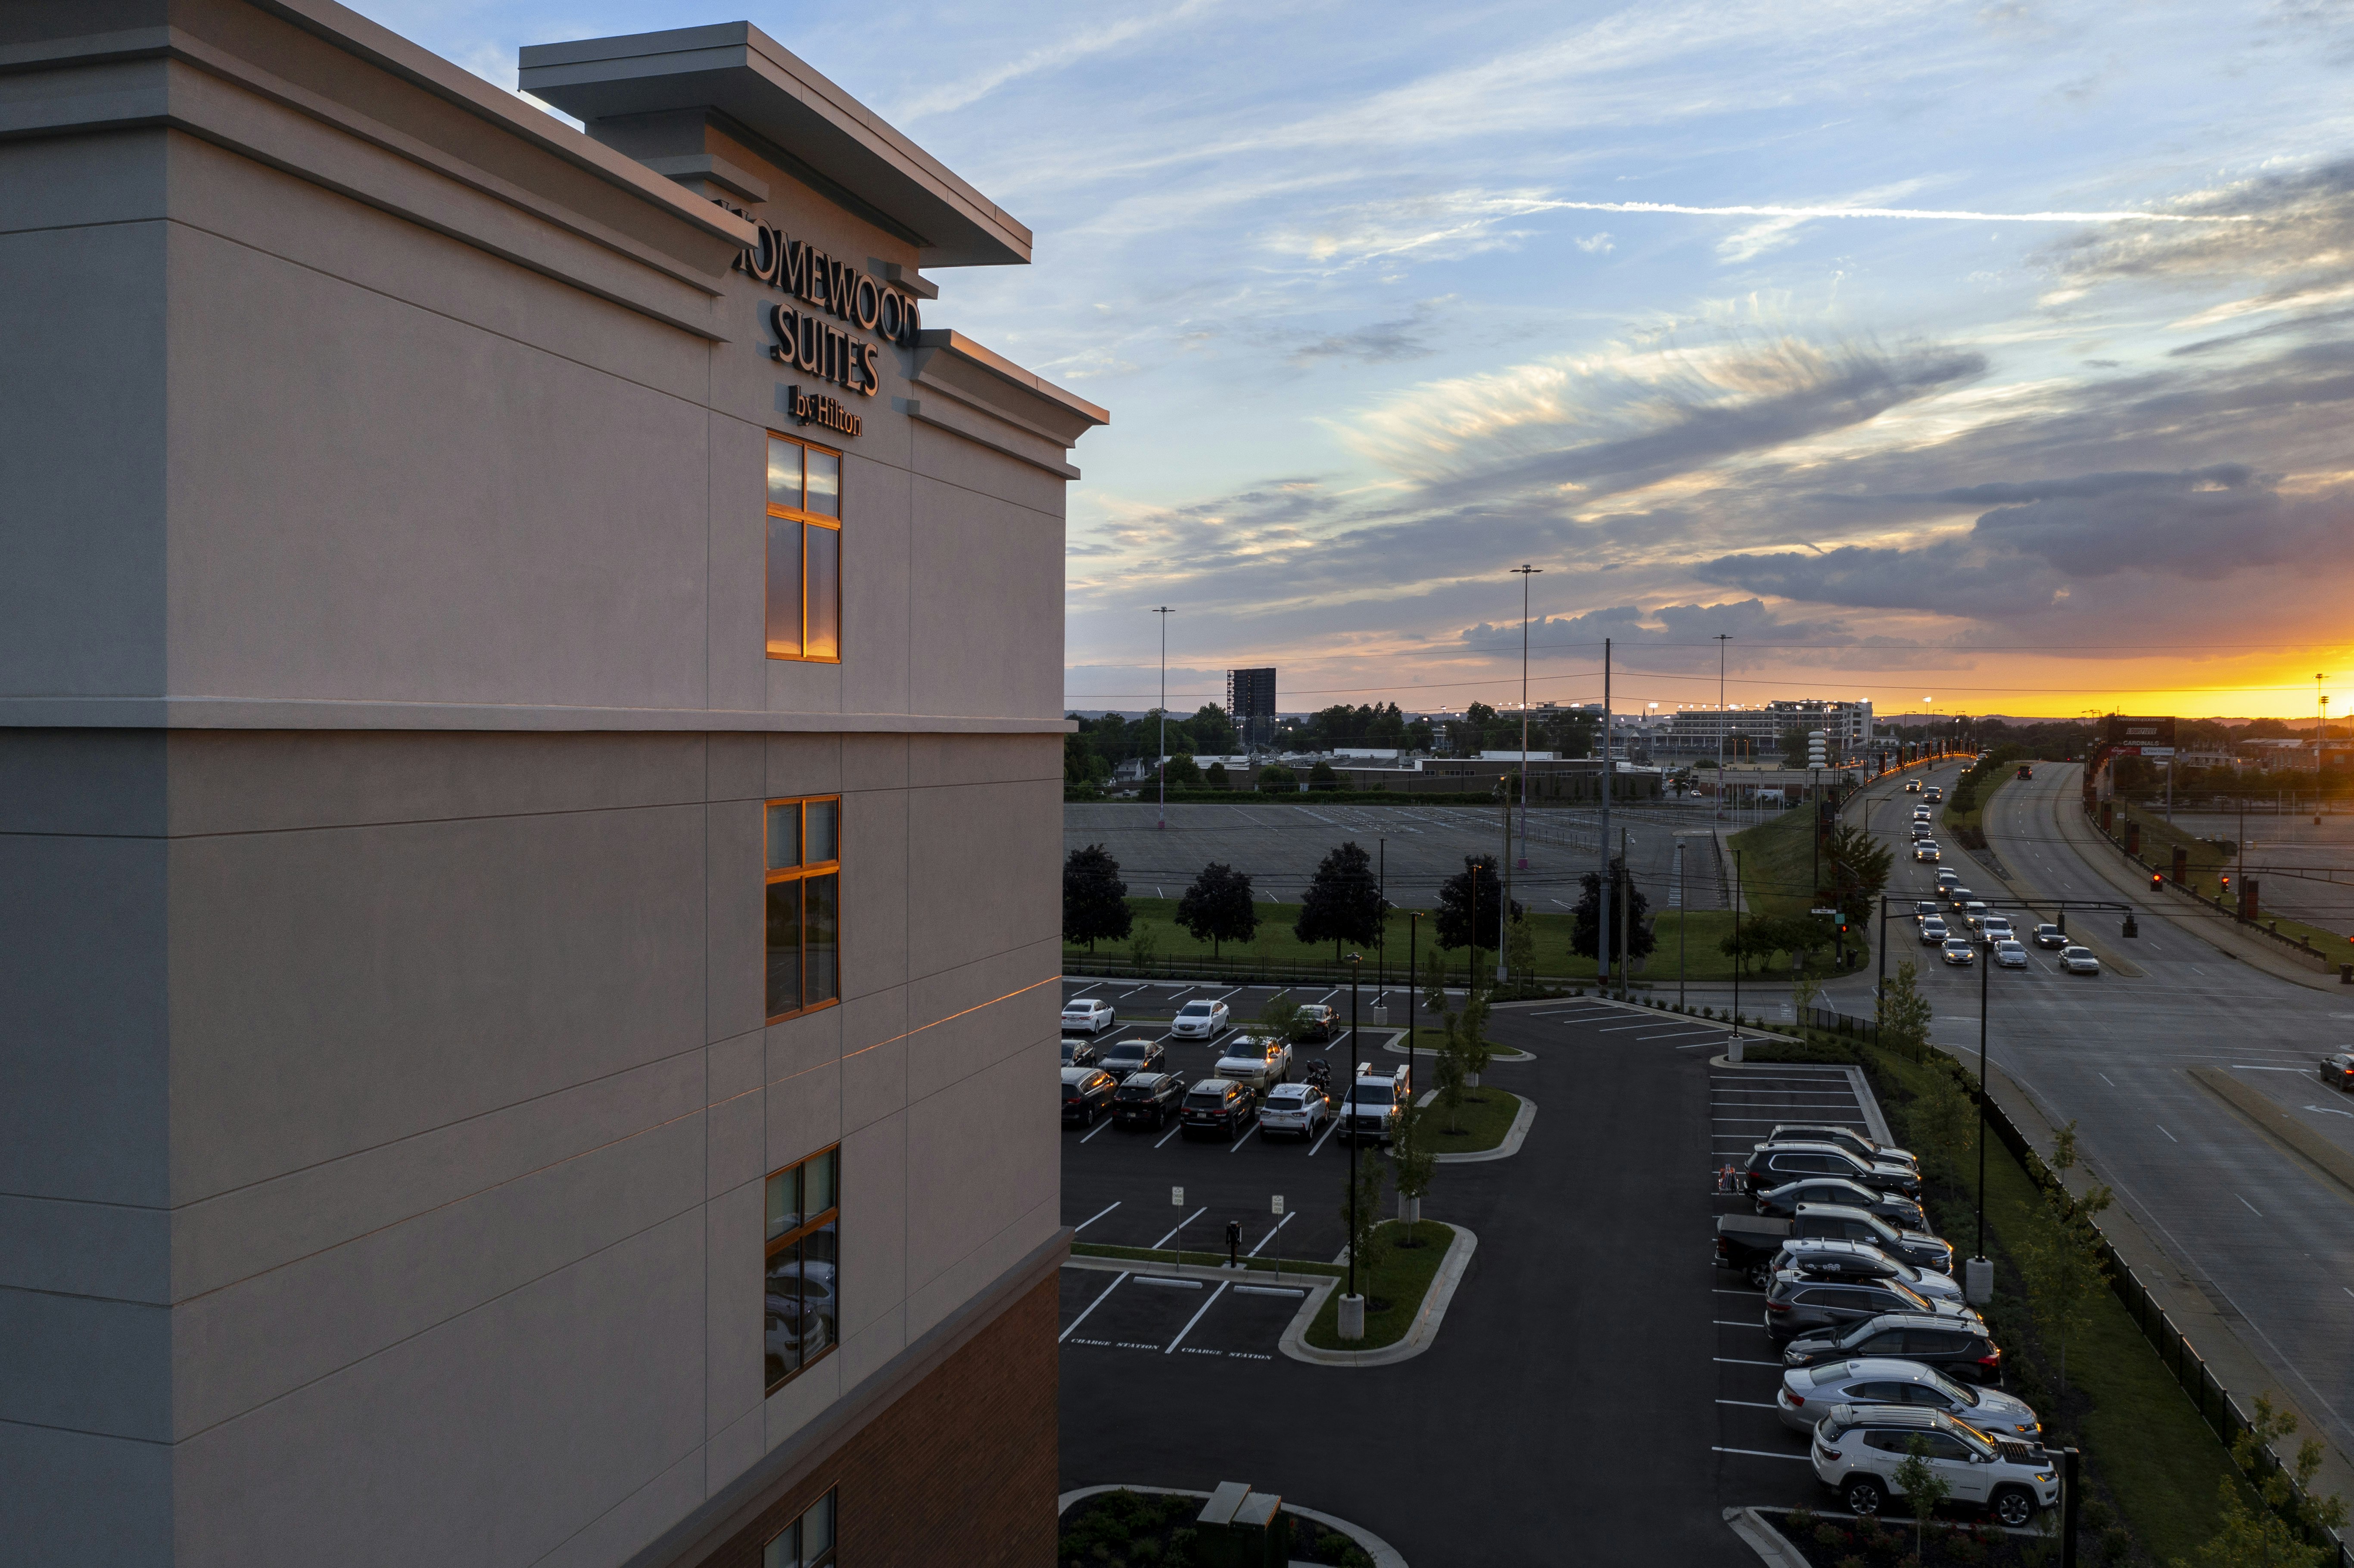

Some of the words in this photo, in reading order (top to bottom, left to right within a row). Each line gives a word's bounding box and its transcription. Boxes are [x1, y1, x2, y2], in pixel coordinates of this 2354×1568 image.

[770, 304, 879, 397] SUITES
[789, 385, 814, 426] by
[816, 394, 863, 437] Hilton
[2111, 746, 2127, 755] Kroger
[1181, 1347, 1223, 1356] CHARGE
[1229, 1352, 1273, 1360] STATION
